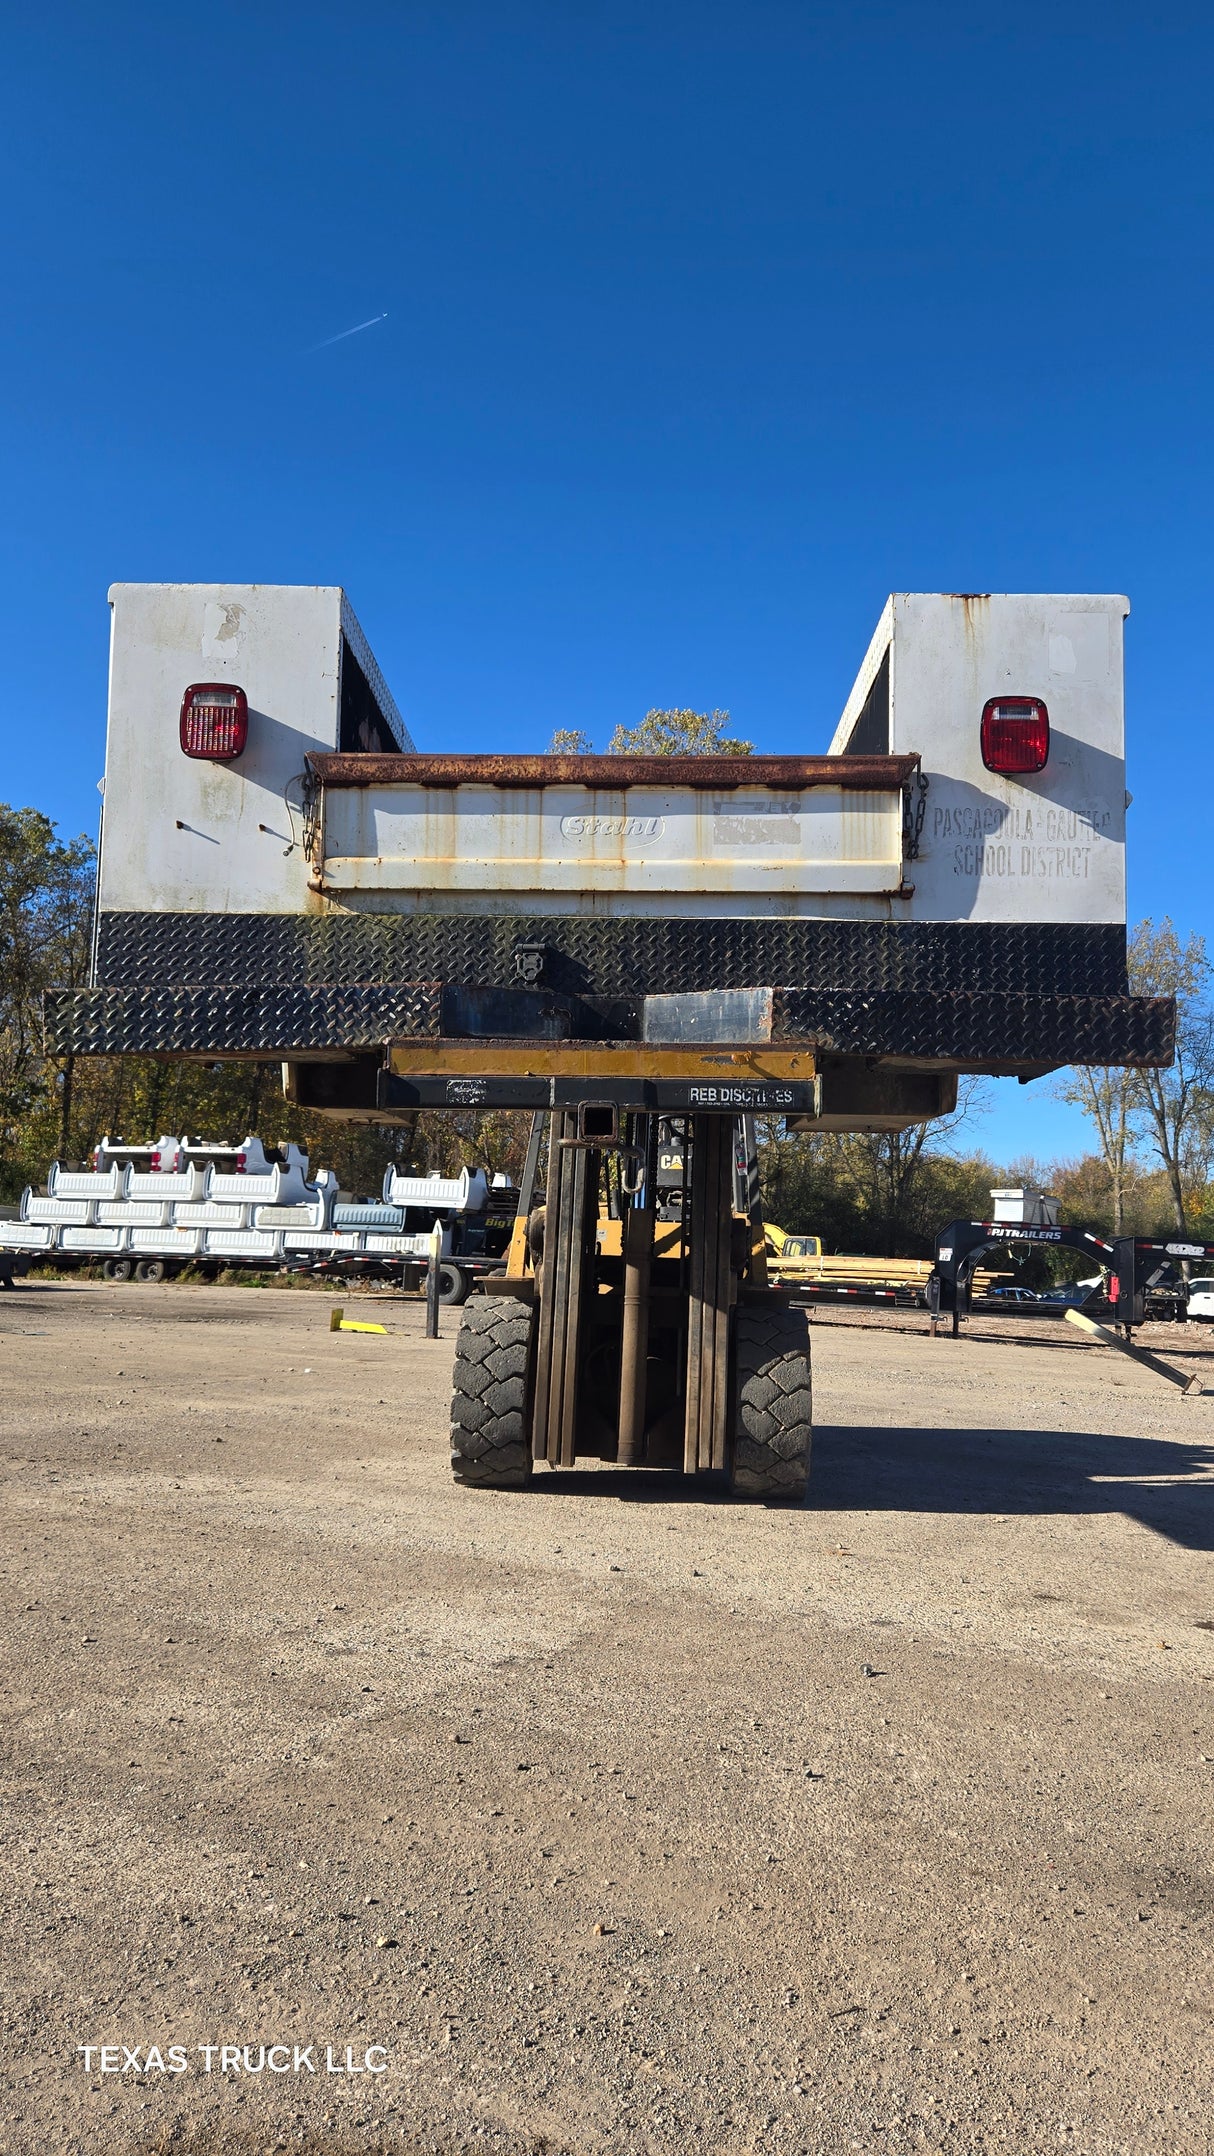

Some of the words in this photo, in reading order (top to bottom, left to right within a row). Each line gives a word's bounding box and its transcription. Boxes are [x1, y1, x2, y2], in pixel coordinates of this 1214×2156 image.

[565, 816, 657, 836] Stahl
[953, 844, 1016, 878] SCHOOL
[1021, 846, 1092, 878] DISTRICT
[660, 1154, 692, 1170] CA
[1004, 1229, 1062, 1240] TRAILERS
